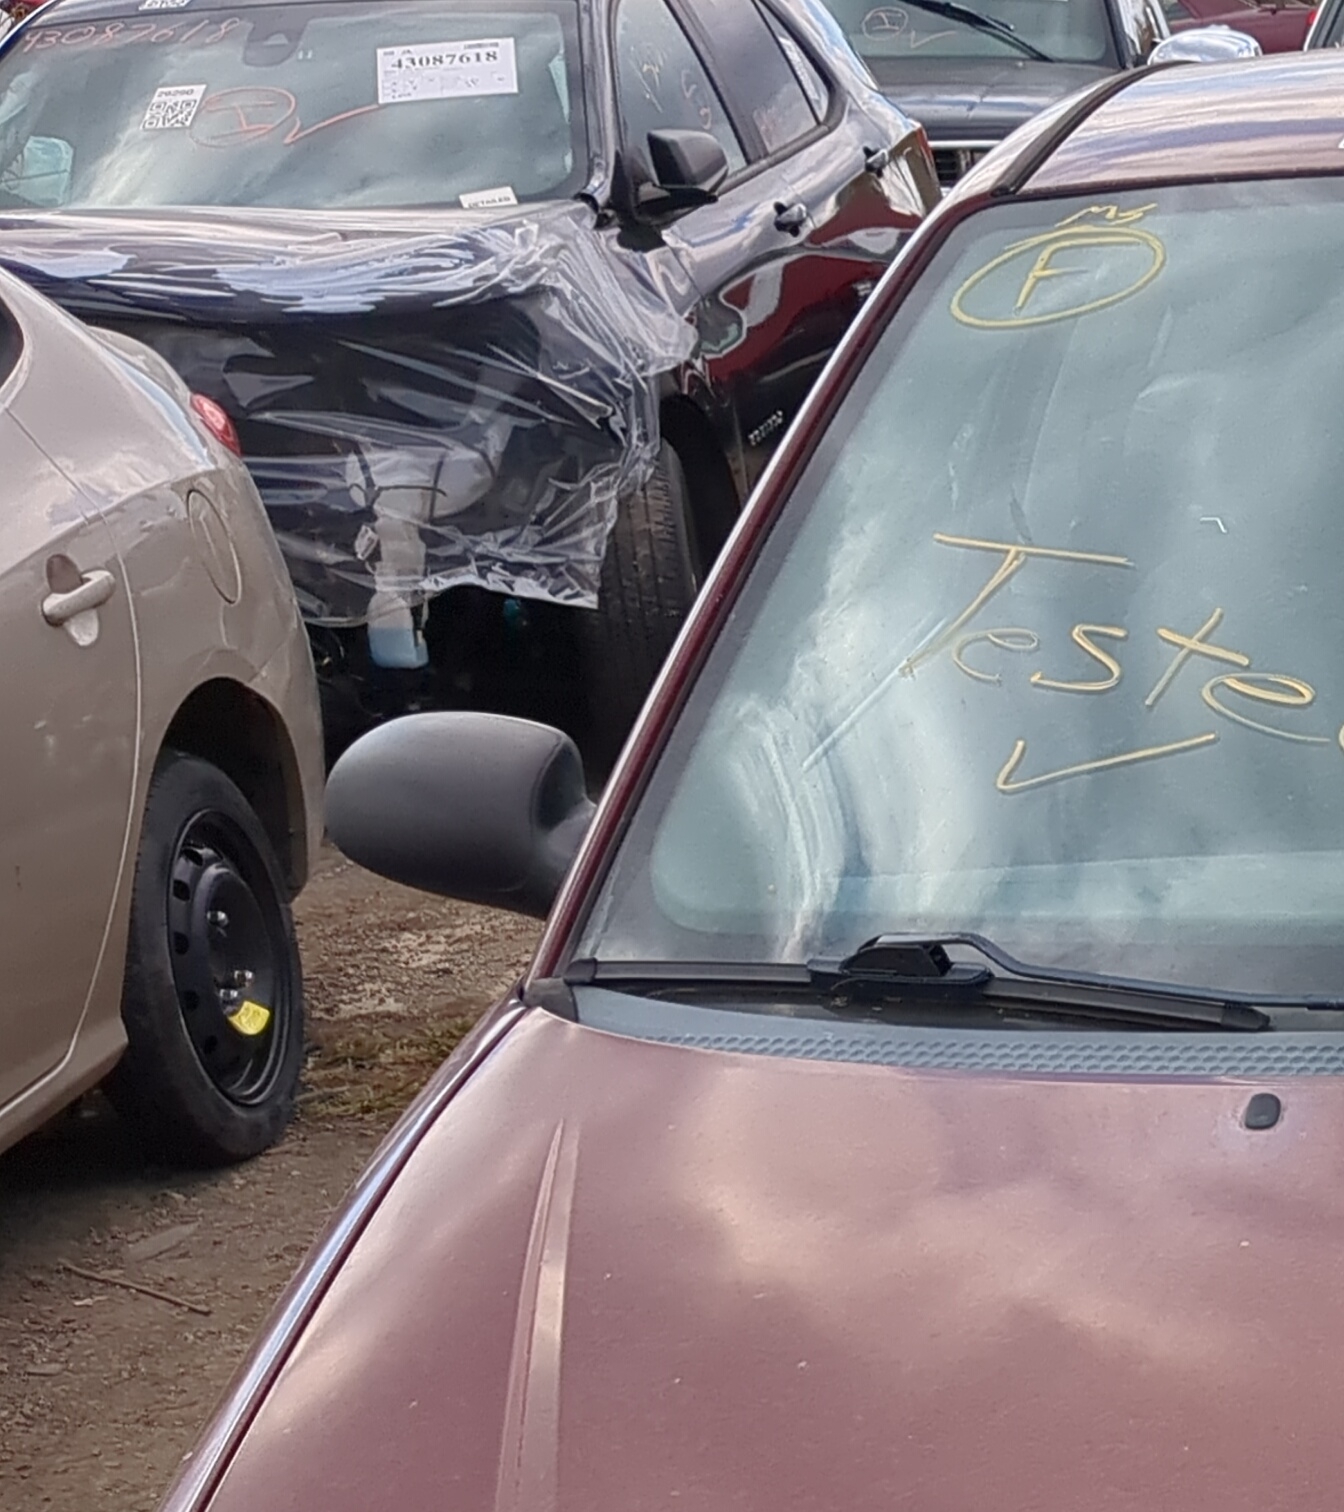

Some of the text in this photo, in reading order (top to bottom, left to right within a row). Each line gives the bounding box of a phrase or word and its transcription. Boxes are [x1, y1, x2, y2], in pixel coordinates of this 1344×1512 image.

[23, 17, 240, 53] 43087618
[391, 51, 498, 69] 43087618
[1013, 236, 1143, 315] F
